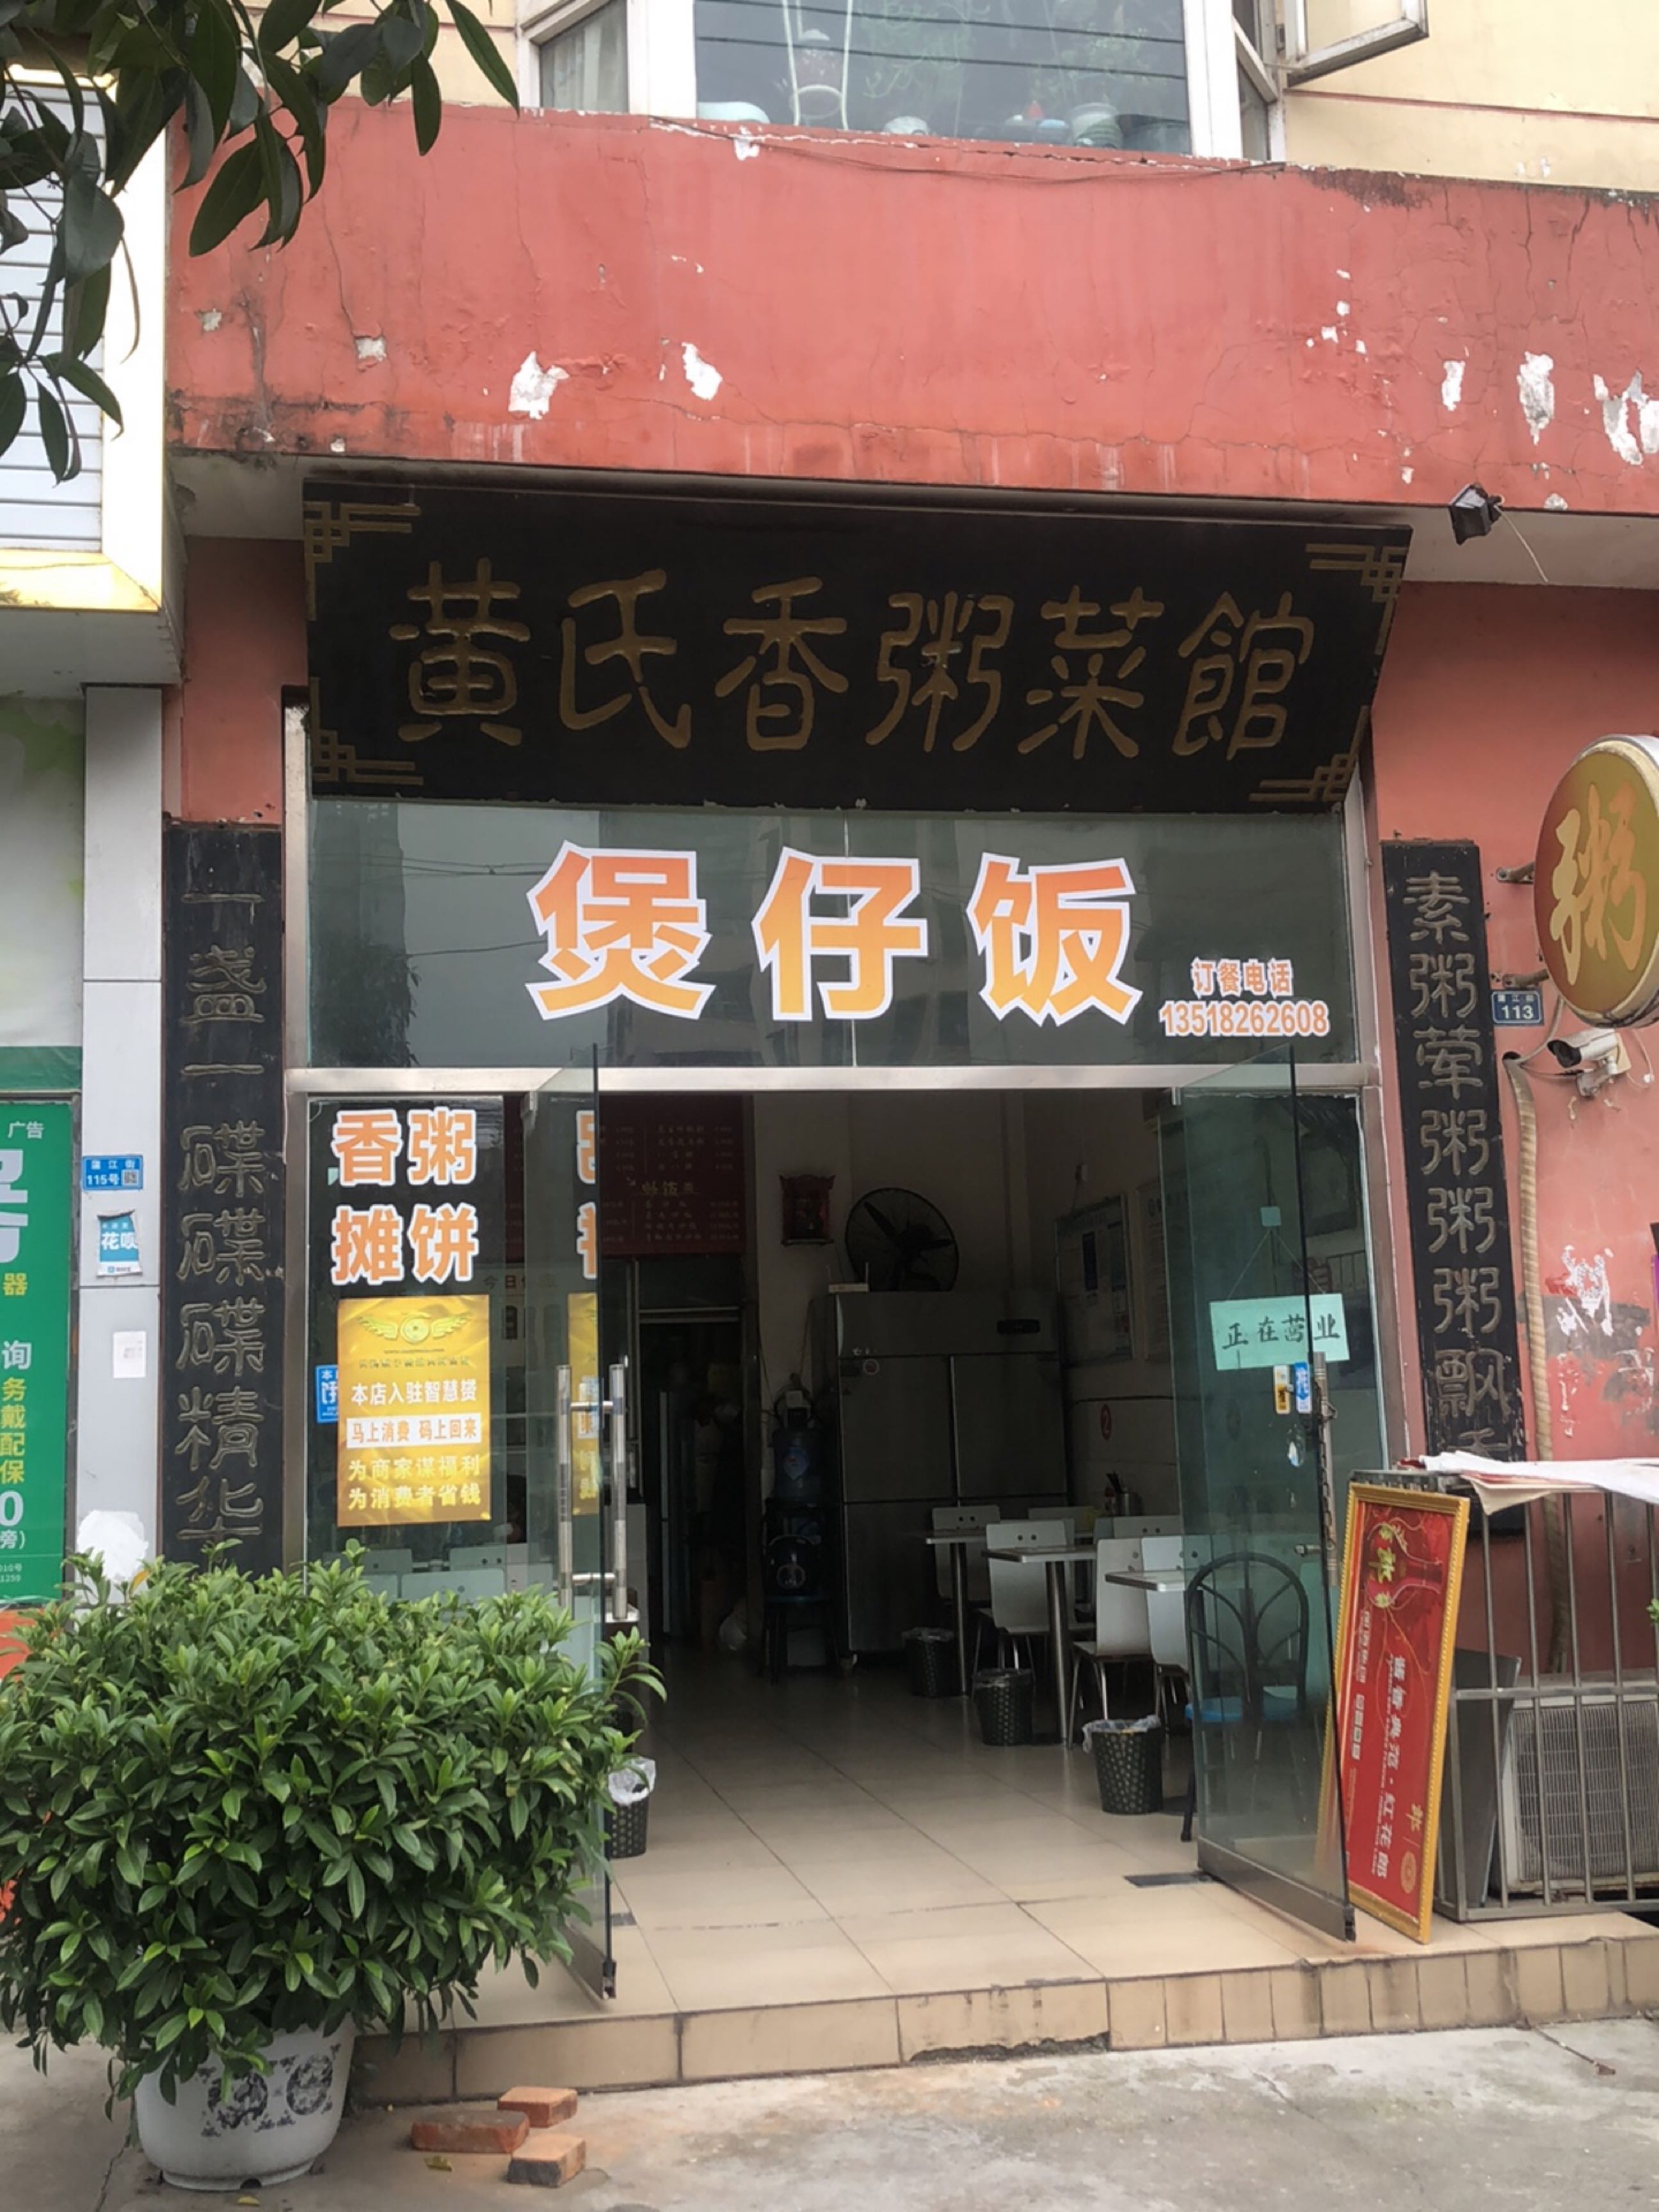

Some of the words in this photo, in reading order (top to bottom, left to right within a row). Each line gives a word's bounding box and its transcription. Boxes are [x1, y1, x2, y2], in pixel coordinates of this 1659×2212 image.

[525, 840, 1144, 1026] 煲仔饭
[1191, 957, 1294, 998] 订餐电话
[1158, 1000, 1329, 1036] 13518262608
[1501, 1004, 1534, 1020] 113
[8, 1121, 44, 1139] 广告
[332, 1106, 476, 1187] 香粥
[86, 1173, 120, 1185] 115号
[331, 1202, 479, 1285] 摊饼
[351, 1419, 410, 1444] 马上消费
[419, 1416, 477, 1441] 码上回来
[348, 1454, 481, 1482] 为商家谋福利
[348, 1482, 481, 1511] 为消费者省钱
